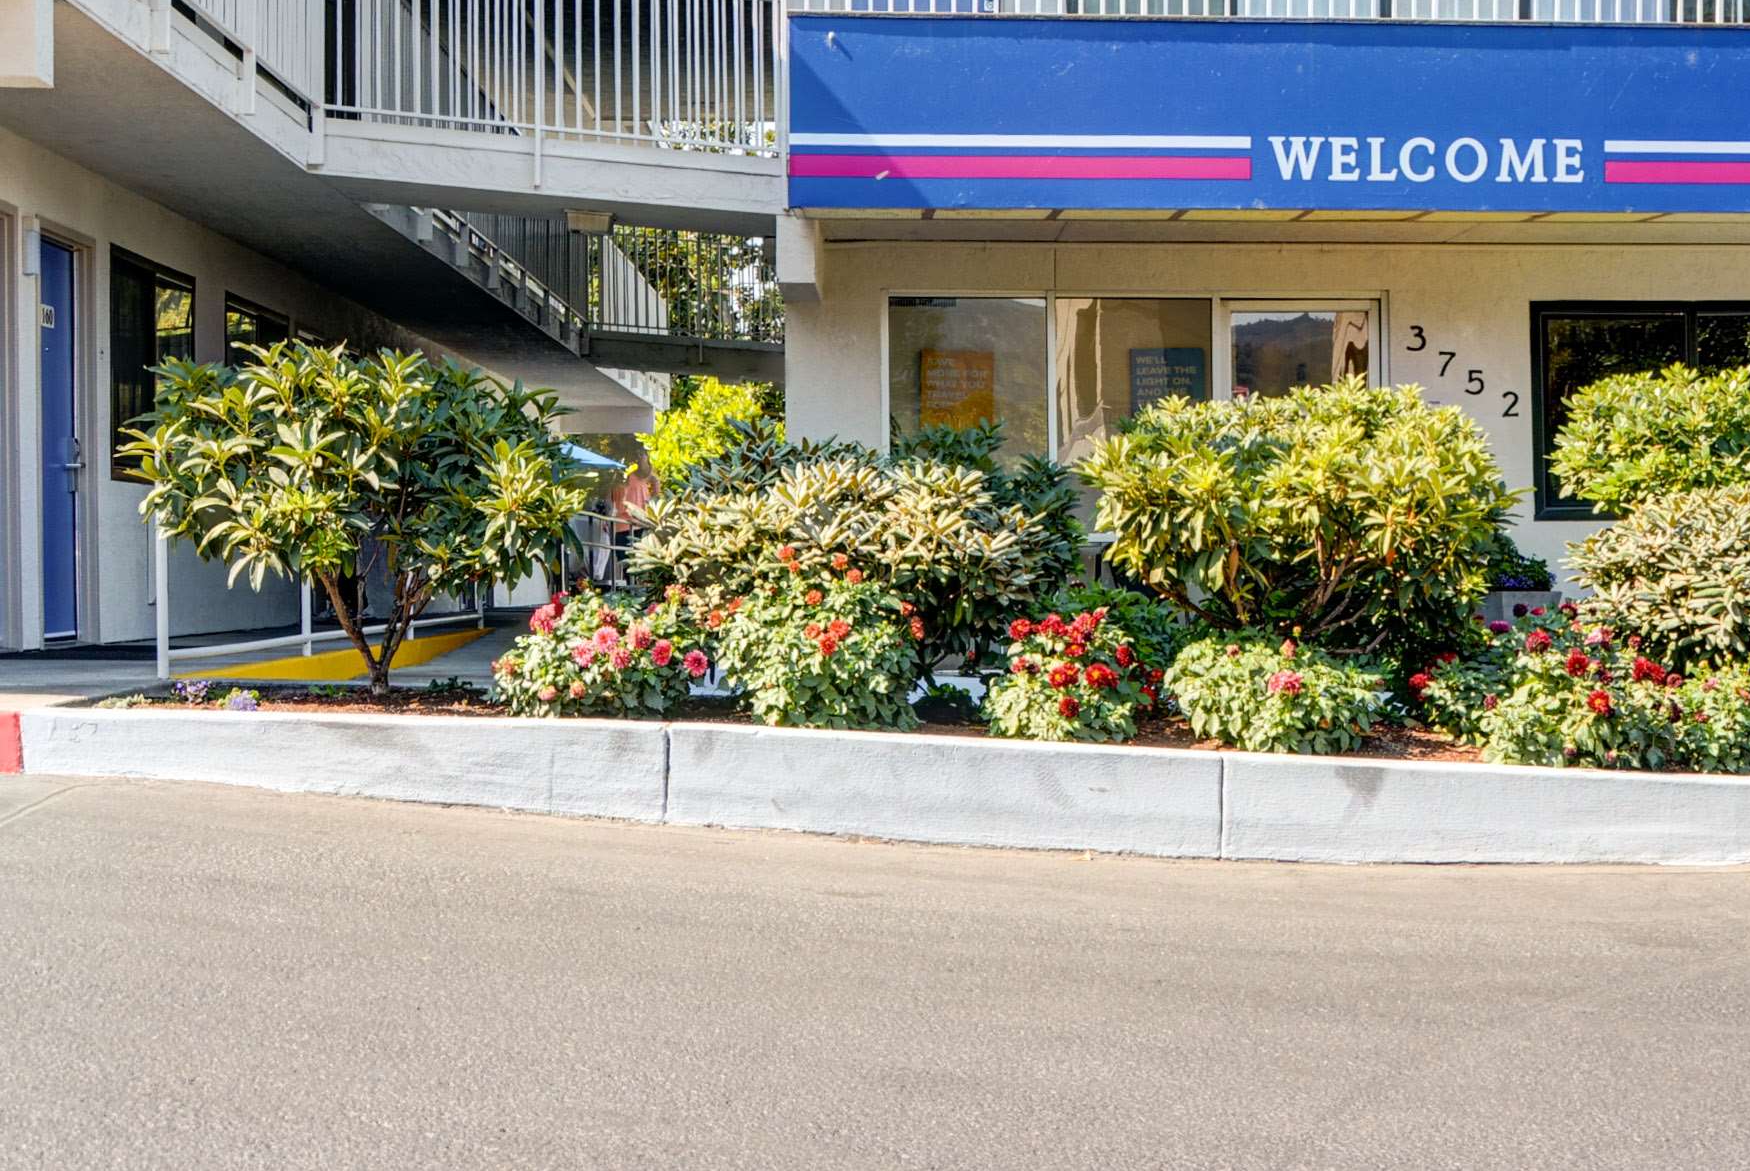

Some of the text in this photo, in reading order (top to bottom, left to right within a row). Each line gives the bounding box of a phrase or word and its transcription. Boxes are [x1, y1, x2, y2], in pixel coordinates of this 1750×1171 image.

[1267, 135, 1585, 183] WELCOME
[1136, 365, 1198, 376] LEAVE THE
[1136, 377, 1169, 386] LIGHT
[1136, 388, 1162, 396] AND
